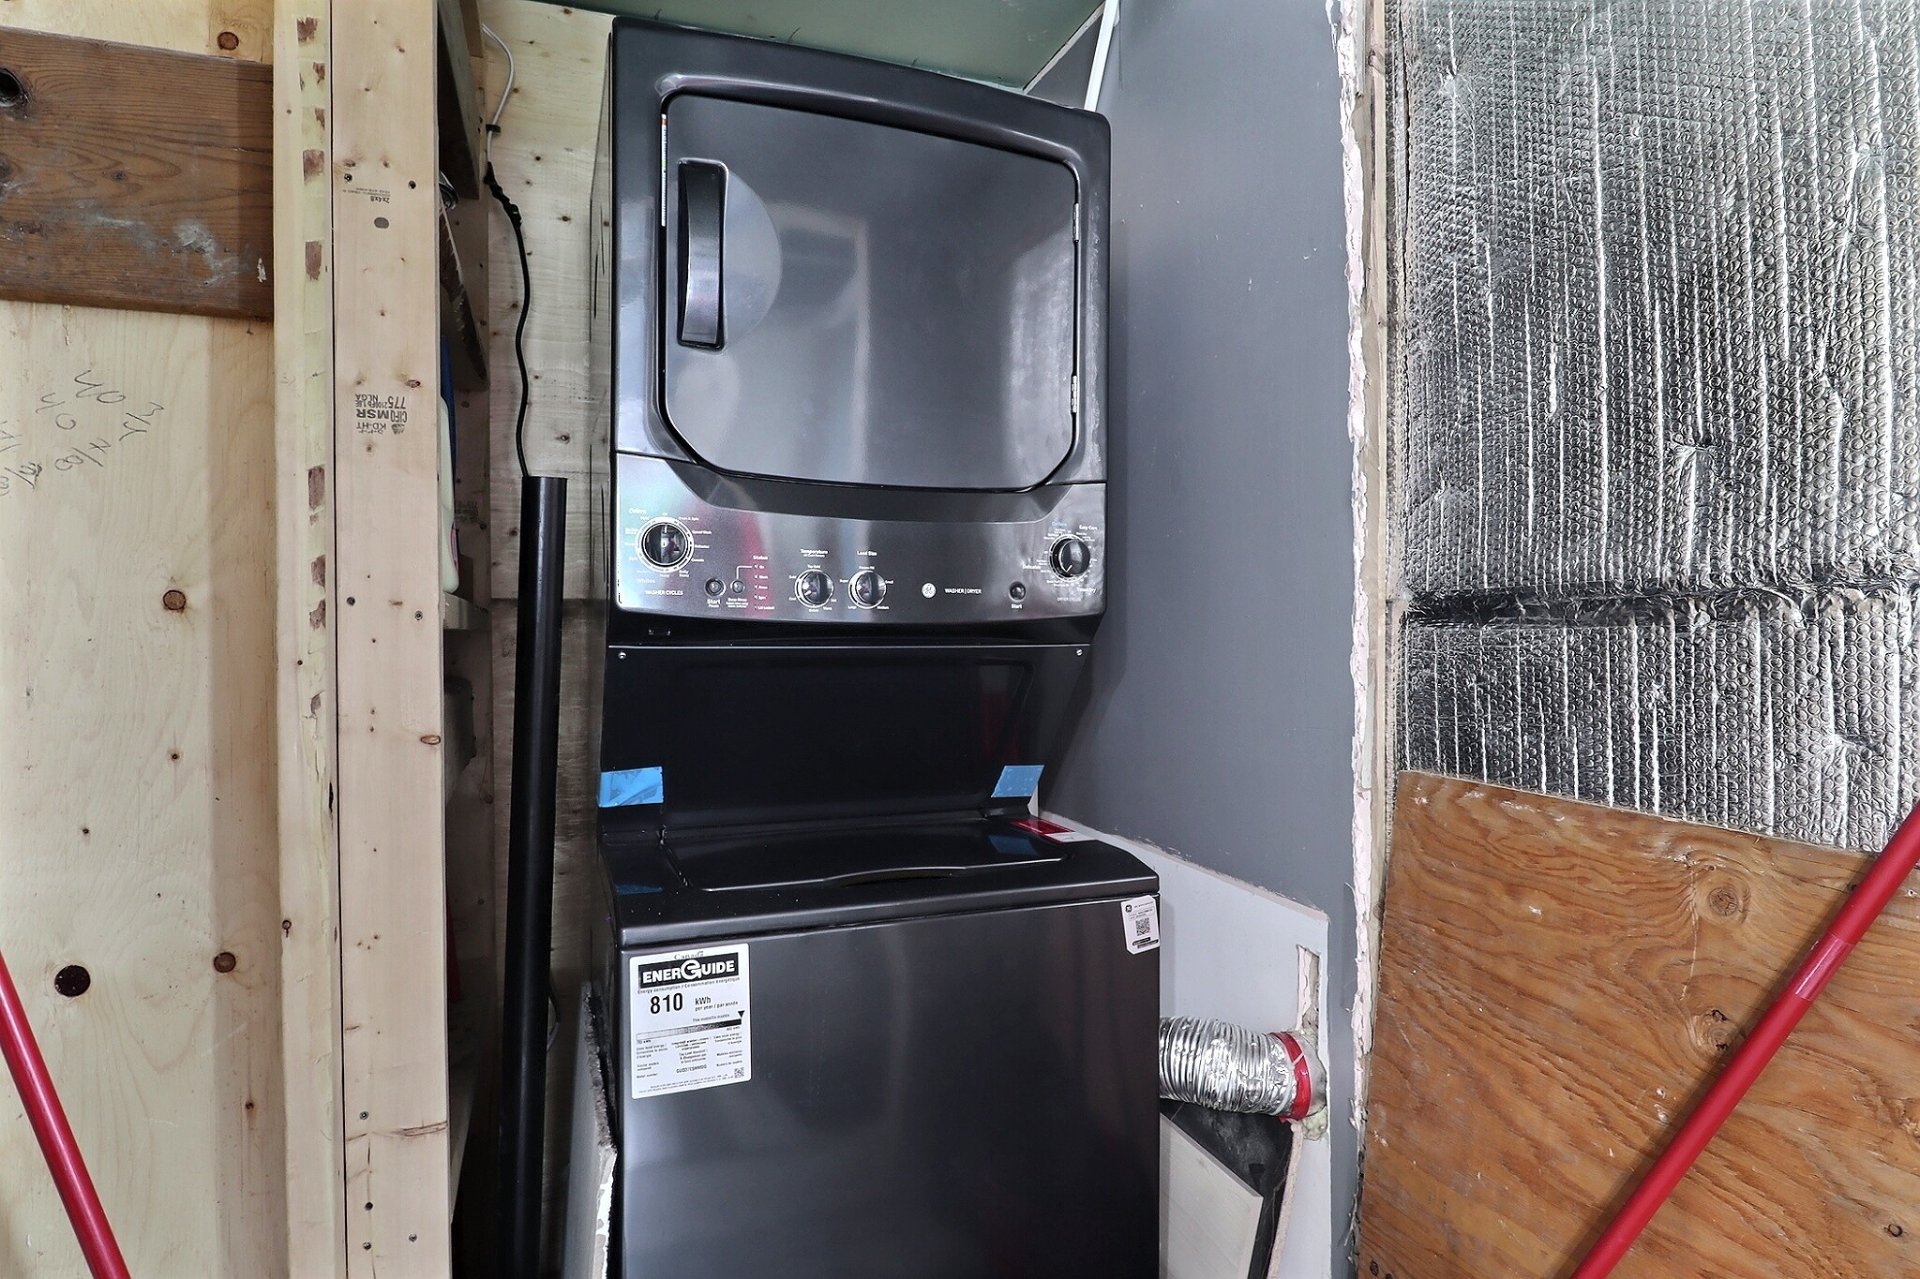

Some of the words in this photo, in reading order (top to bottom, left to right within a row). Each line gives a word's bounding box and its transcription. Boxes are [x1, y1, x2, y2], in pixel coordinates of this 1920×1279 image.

[387, 395, 406, 409] 775
[356, 408, 389, 419] MSR
[642, 959, 736, 984] ENERGUIDE
[650, 992, 684, 1014] 810
[695, 996, 712, 1006] kWh
